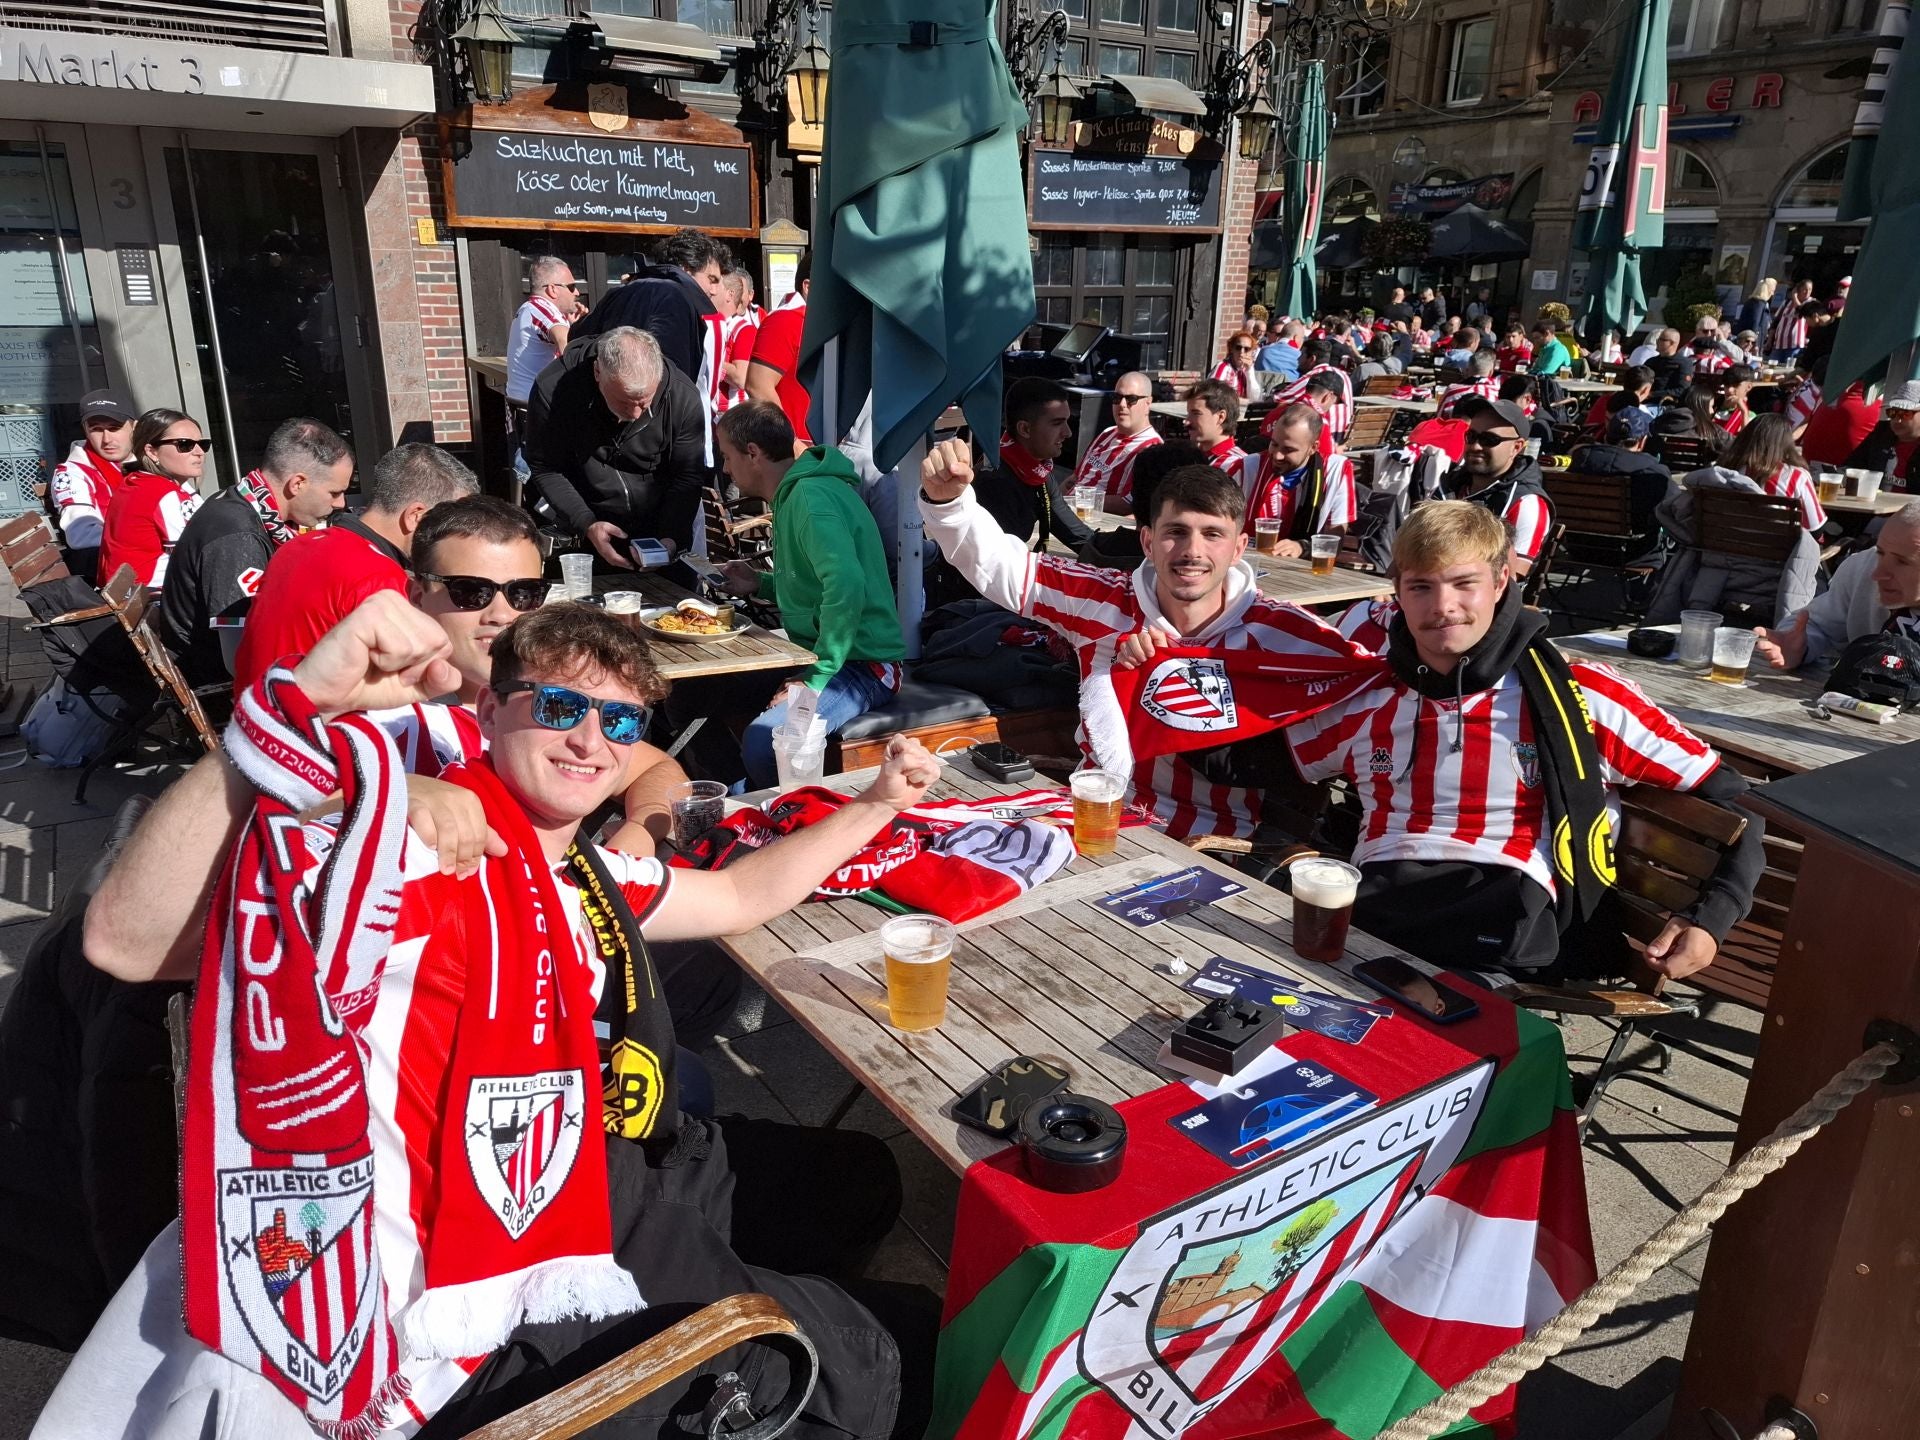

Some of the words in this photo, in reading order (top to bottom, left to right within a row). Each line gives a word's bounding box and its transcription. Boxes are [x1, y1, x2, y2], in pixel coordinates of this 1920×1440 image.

[18, 41, 161, 91] Markt
[181, 57, 206, 95] 3
[1573, 73, 1784, 122] ALER
[1094, 115, 1178, 141] Kulinarisches
[1116, 138, 1158, 155] Fenster
[497, 136, 617, 166] Salzkuchen
[619, 144, 646, 167] mit
[654, 147, 695, 176] Mett,
[1128, 161, 1152, 177] Spritz
[1158, 161, 1176, 173] 7,50€
[109, 177, 137, 210] 3
[516, 170, 564, 193] Käse
[570, 172, 609, 194] oder
[617, 170, 720, 213] Kümmelmagen
[554, 202, 581, 216] außer
[1171, 208, 1197, 221] NEU!!!
[1142, 678, 1168, 717] BILBAO
[1225, 697, 1235, 724] CLUB
[533, 949, 552, 1046] CLUB
[540, 1074, 574, 1088] CLUB
[1181, 1112, 1209, 1130] SCARF
[226, 1173, 330, 1197] ATHLETIC
[338, 1159, 374, 1187] CLU
[1156, 1139, 1365, 1249] ATHLETIC
[1377, 1086, 1473, 1152] CLUB
[502, 1185, 545, 1233] BILBAO
[287, 1326, 359, 1394] BILBAO
